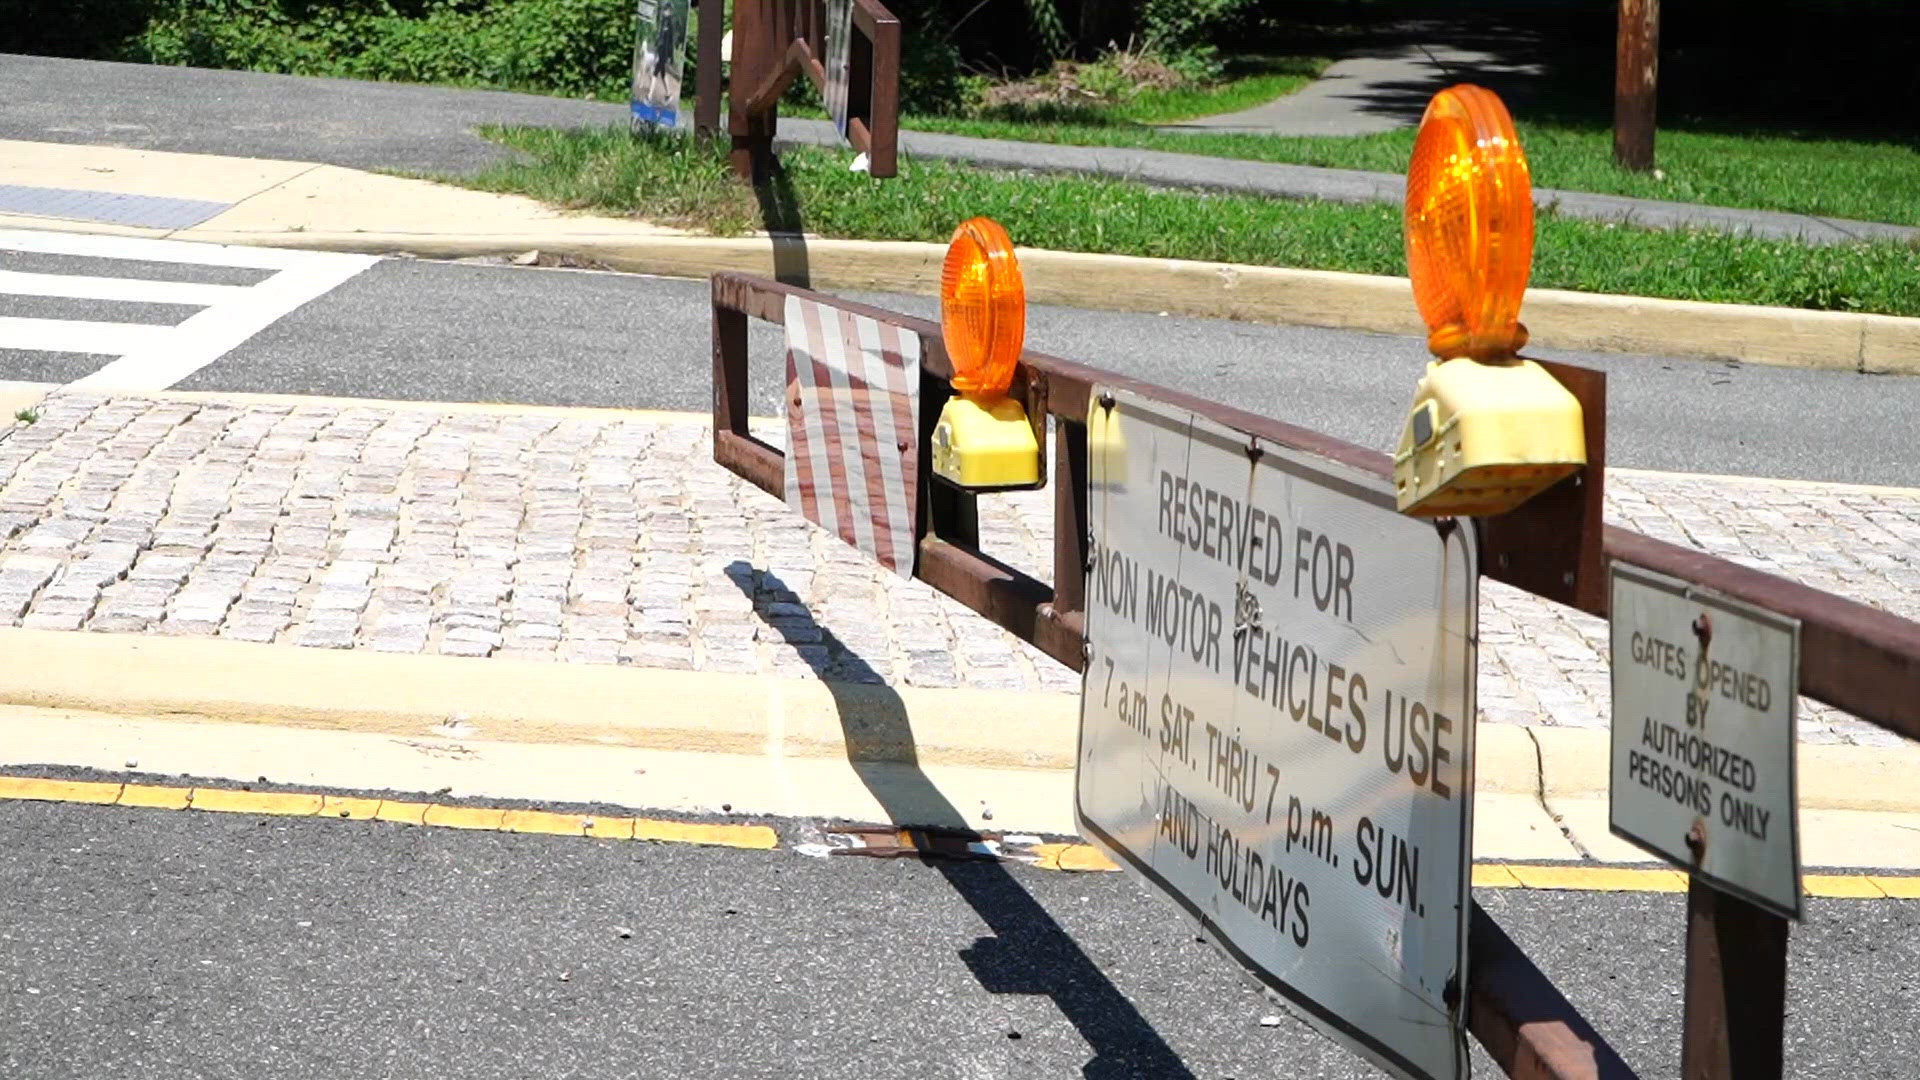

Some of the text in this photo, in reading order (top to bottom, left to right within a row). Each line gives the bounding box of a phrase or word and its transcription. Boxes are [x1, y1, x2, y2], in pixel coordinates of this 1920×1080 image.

[1159, 471, 1355, 622] RESERVED FOR
[1096, 543, 1453, 800] NON MOTOR VEHICLES USE
[1631, 631, 1770, 712] GATES OPENED
[1686, 692, 1710, 731] BY
[1103, 655, 1425, 918] 7 a.m. SAT. THRU 7 p.m. SUN.
[1630, 750, 1770, 840] PERSONS ONLY
[1642, 717, 1756, 794] AUTHORIZED
[1160, 785, 1310, 948] AND HOLIDAYS
